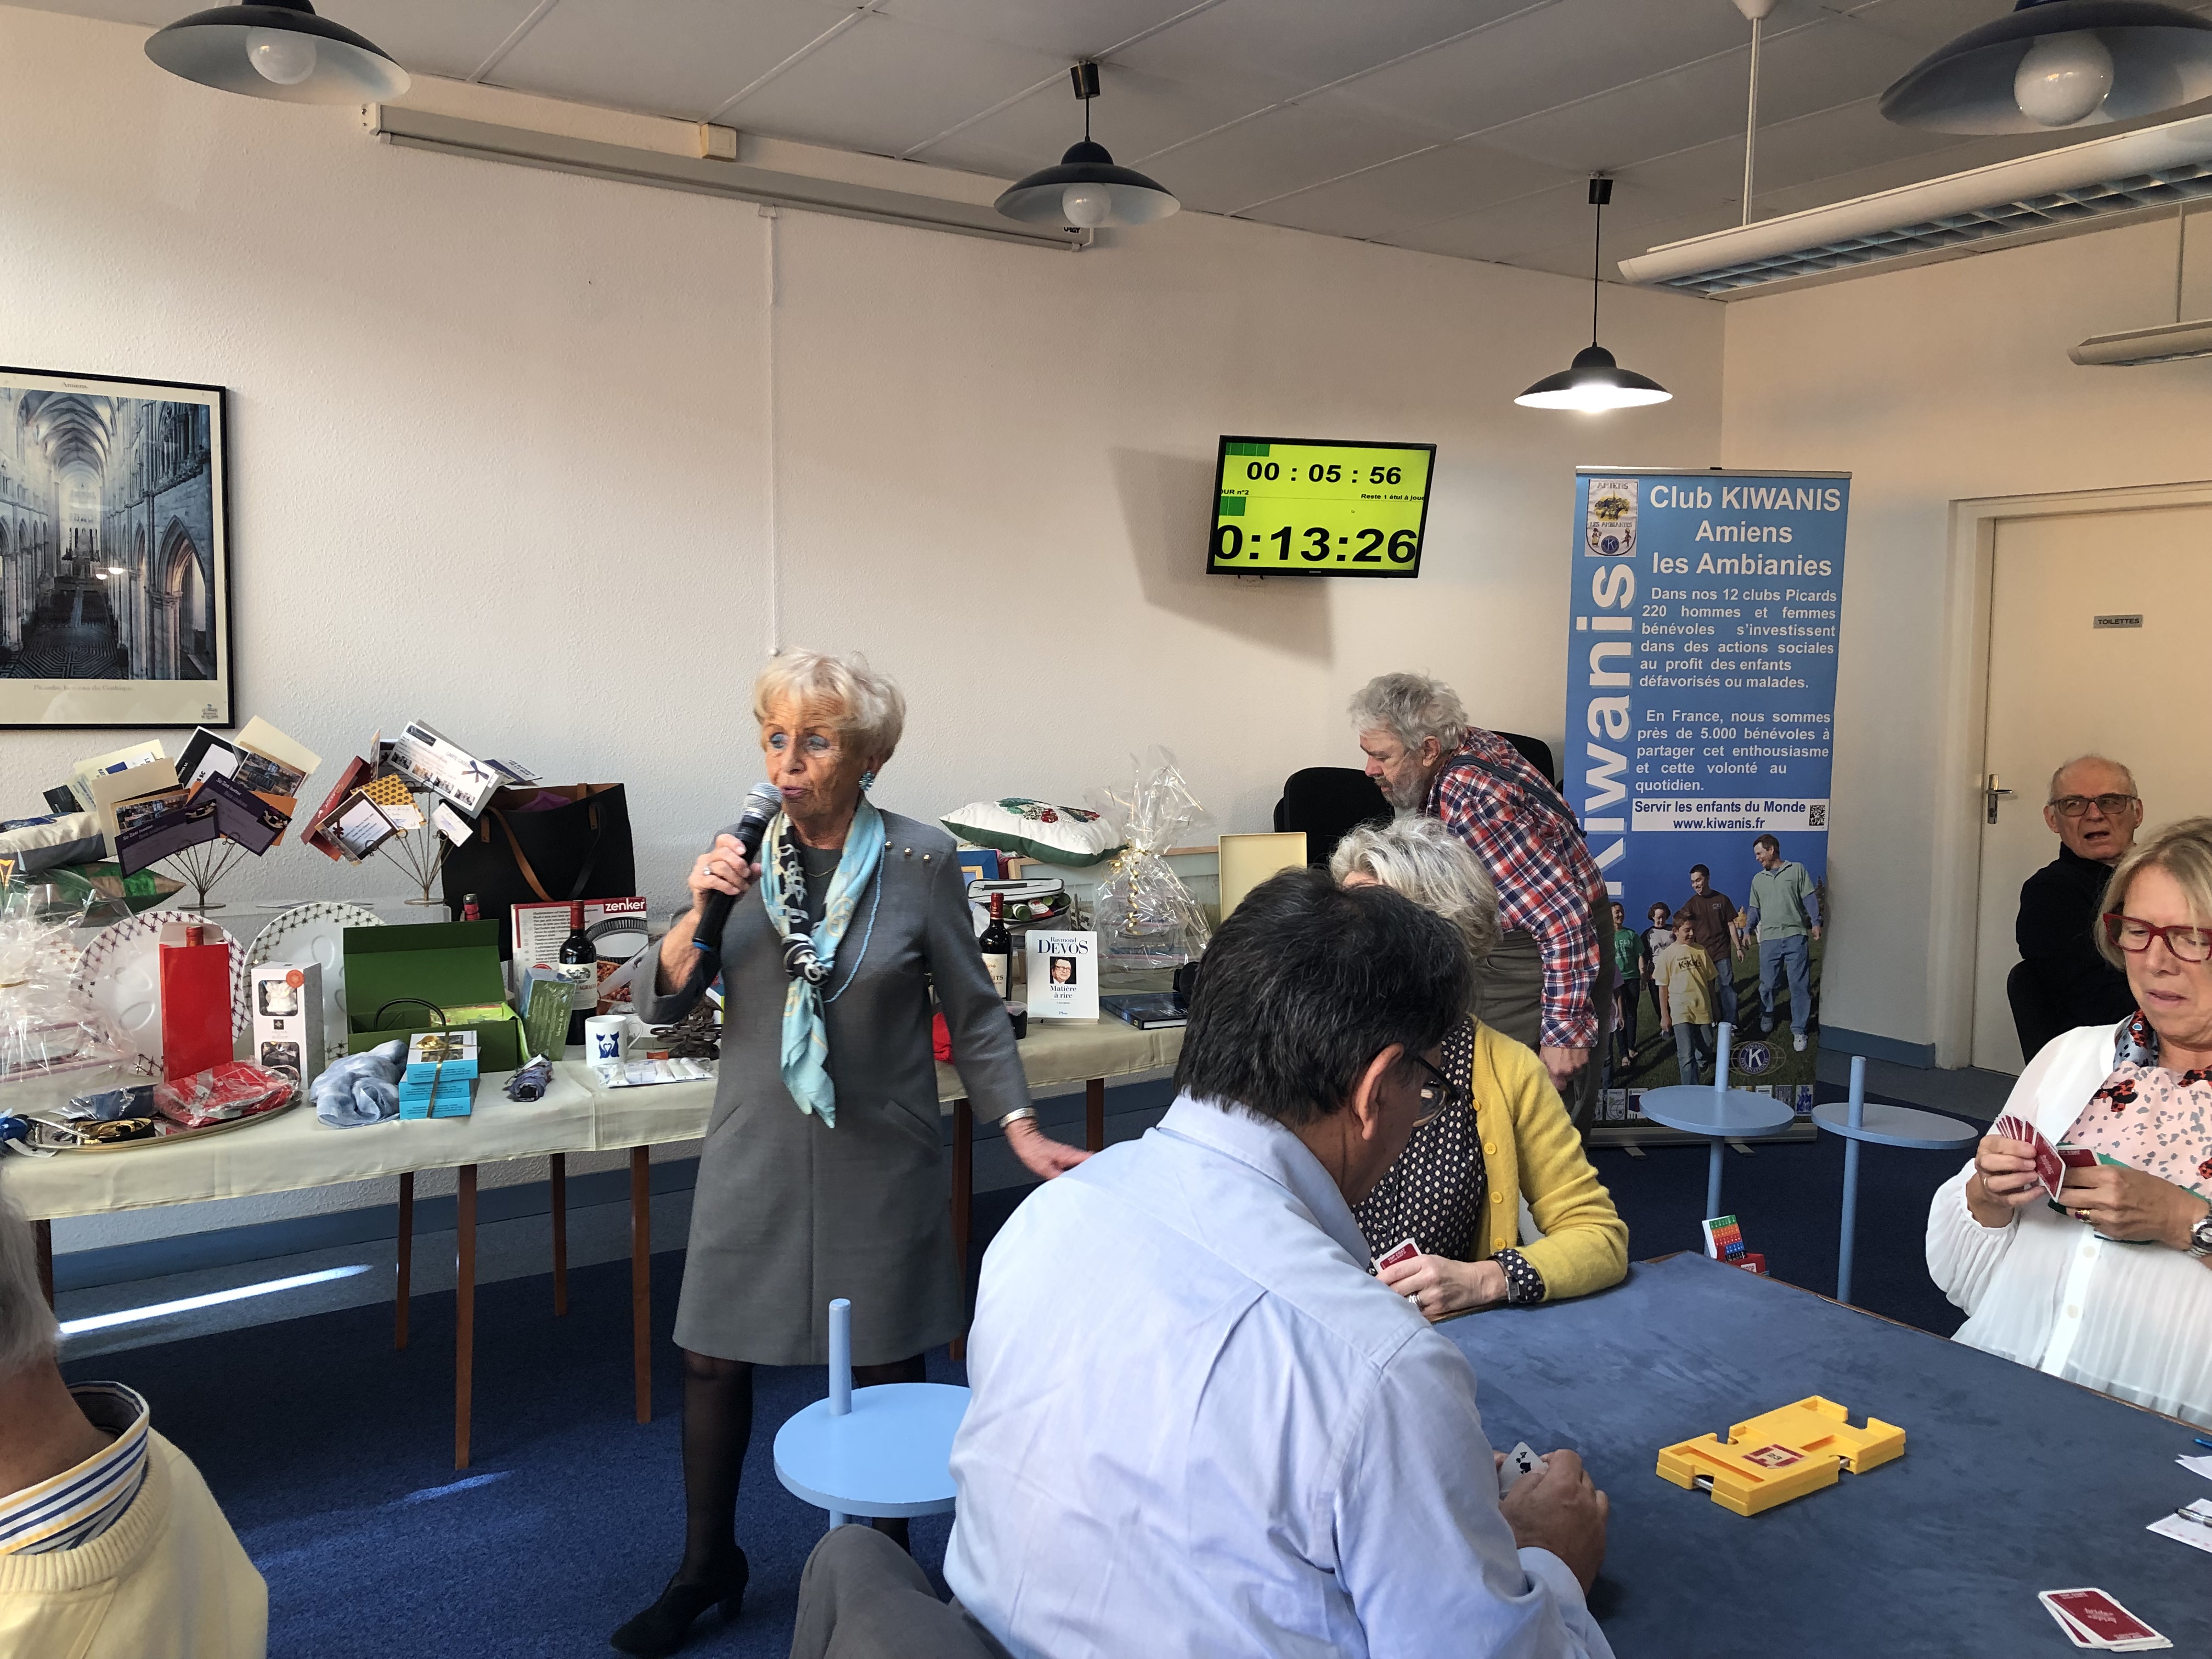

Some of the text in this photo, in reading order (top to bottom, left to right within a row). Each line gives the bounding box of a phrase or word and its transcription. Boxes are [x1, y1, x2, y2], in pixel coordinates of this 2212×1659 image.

[1247, 462, 1280, 481] 00
[1308, 464, 1341, 483] 05
[1369, 466, 1402, 484] 56
[1596, 482, 1629, 490] AMIENS
[1650, 486, 1841, 511] Club KIWANIS
[1695, 520, 1792, 543] Amiens
[1652, 553, 1832, 577] les Ambianies
[1651, 588, 1837, 602] Dans nos 12 clubs Picards
[1642, 605, 1836, 619] 220 hommes et femmes
[1641, 623, 1836, 637] bénévoles s'investissent
[1640, 641, 1834, 654] dans des actions sociales
[1640, 658, 1792, 673] au profit des enfants
[1639, 674, 1809, 689] défavorisés ou malades.
[1646, 709, 1831, 724] En France, nous sommes
[1638, 726, 1830, 742] près de 5.000 bénévoles à
[1637, 744, 1829, 759] partager cet enthousiasme
[1636, 762, 1787, 774] et cette volonté au
[1635, 780, 1704, 793] quotidien.
[1635, 801, 1805, 813] Servir les enfants du Monde
[1673, 817, 1765, 830] www.kiwanis.fr
[605, 898, 645, 911] zenker
[1037, 939, 1088, 955] DEVOS
